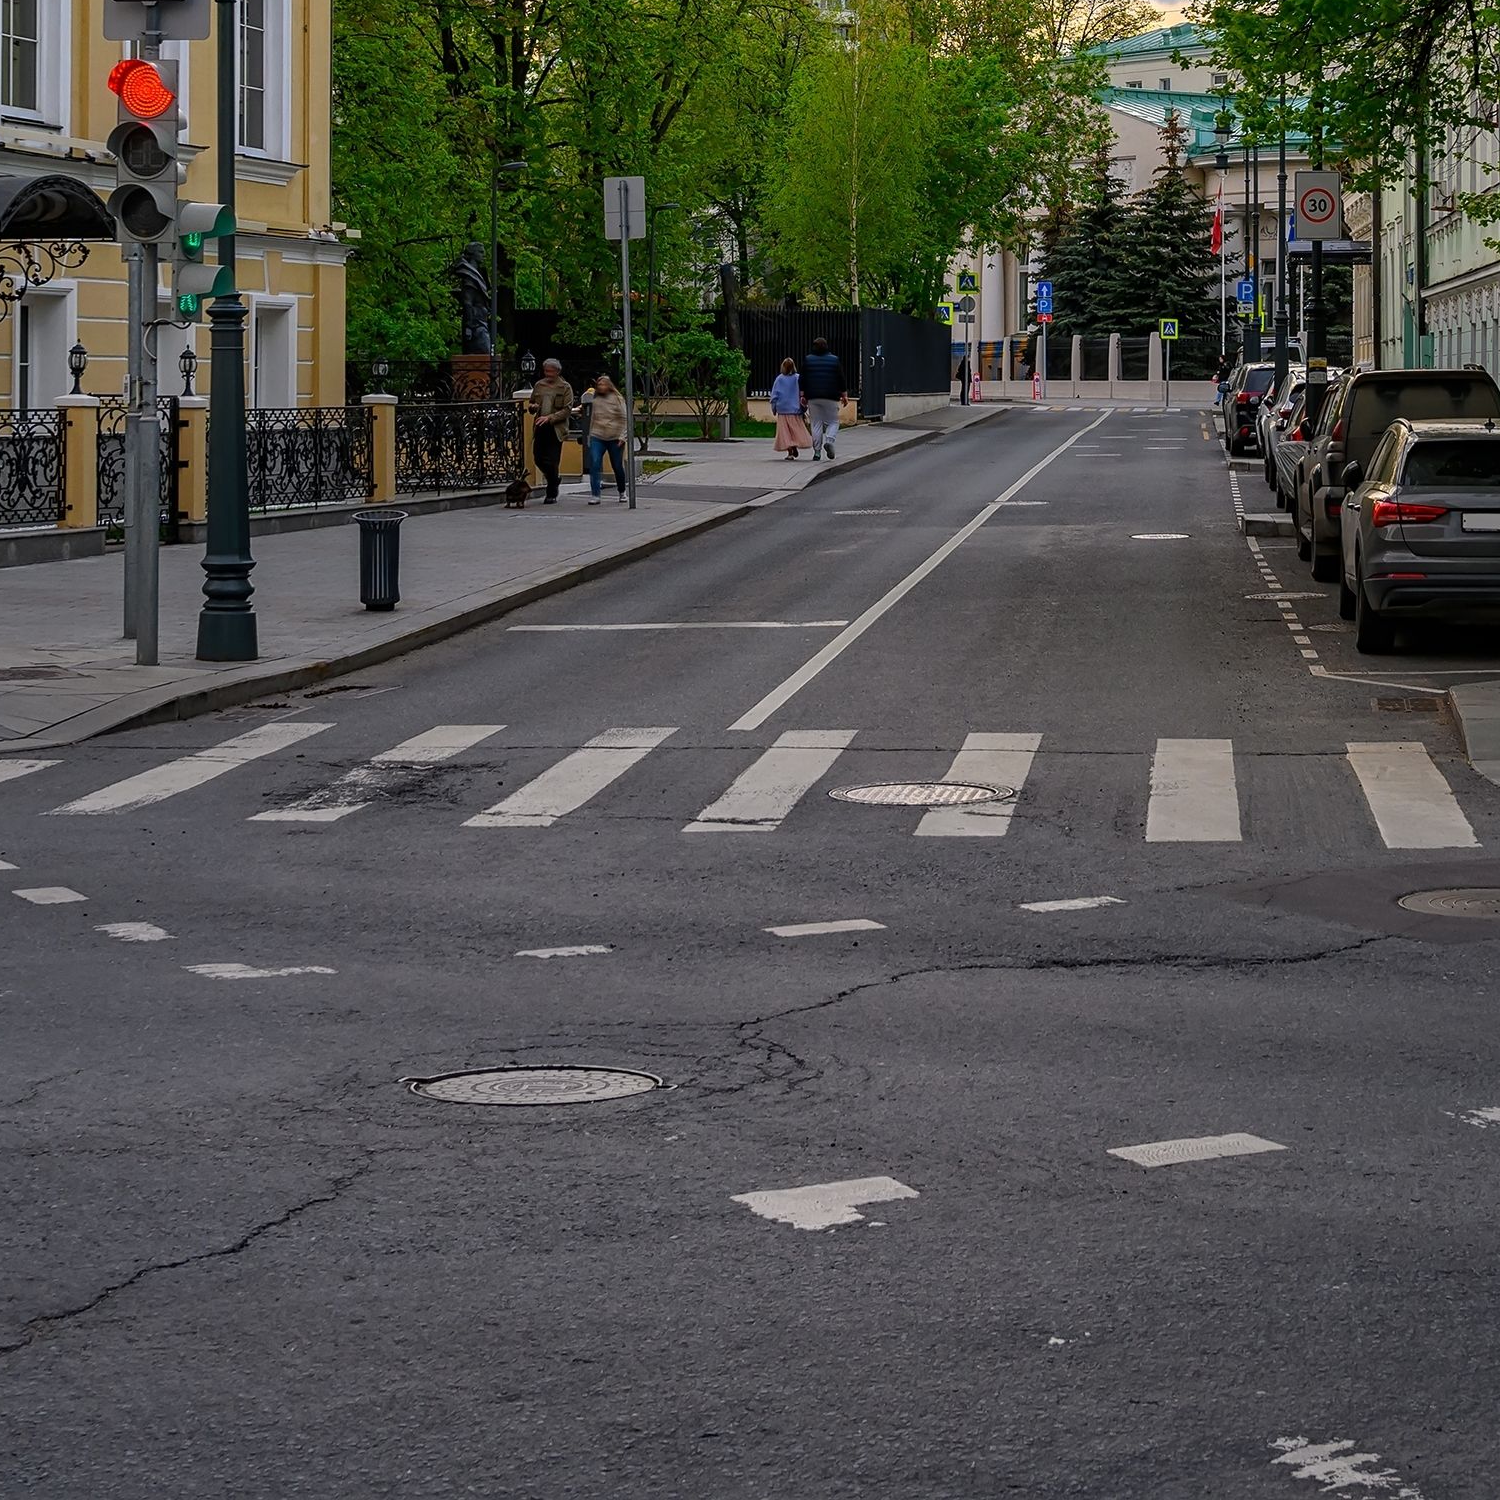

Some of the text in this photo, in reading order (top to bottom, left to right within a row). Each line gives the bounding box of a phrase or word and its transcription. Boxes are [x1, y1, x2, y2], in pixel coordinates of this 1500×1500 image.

[1308, 198, 1327, 213] 30
[1242, 283, 1253, 300] P
[1039, 300, 1048, 312] P
